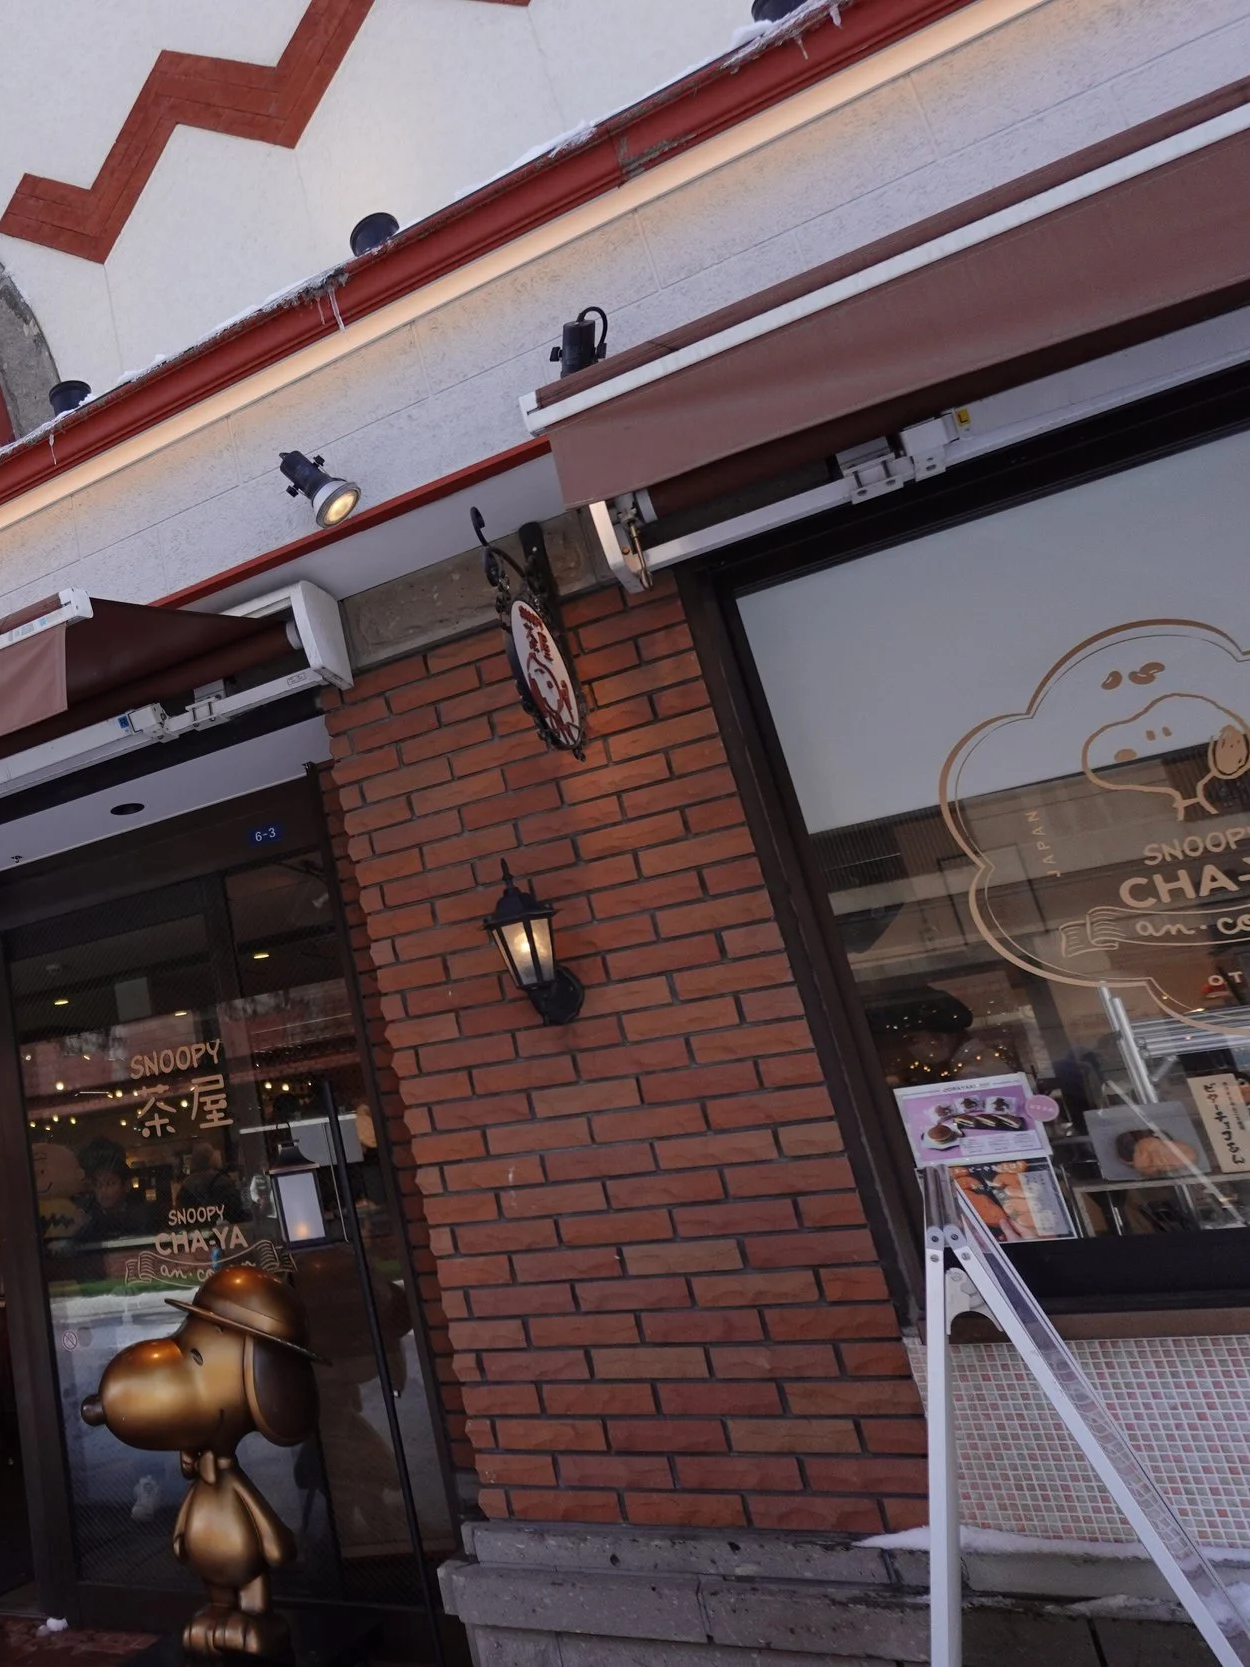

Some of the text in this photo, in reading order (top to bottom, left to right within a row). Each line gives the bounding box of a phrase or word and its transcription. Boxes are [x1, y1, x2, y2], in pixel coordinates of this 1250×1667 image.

[255, 827, 277, 842] 6-3
[1025, 811, 1062, 877] JAPAN
[1143, 826, 1250, 866] SNOOP
[1119, 856, 1250, 909] CHA-
[130, 1040, 223, 1080] SNOOPY
[137, 1074, 233, 1139] 茶屋
[168, 1204, 225, 1226] SNOOPY
[155, 1225, 249, 1256] CHA-YA
